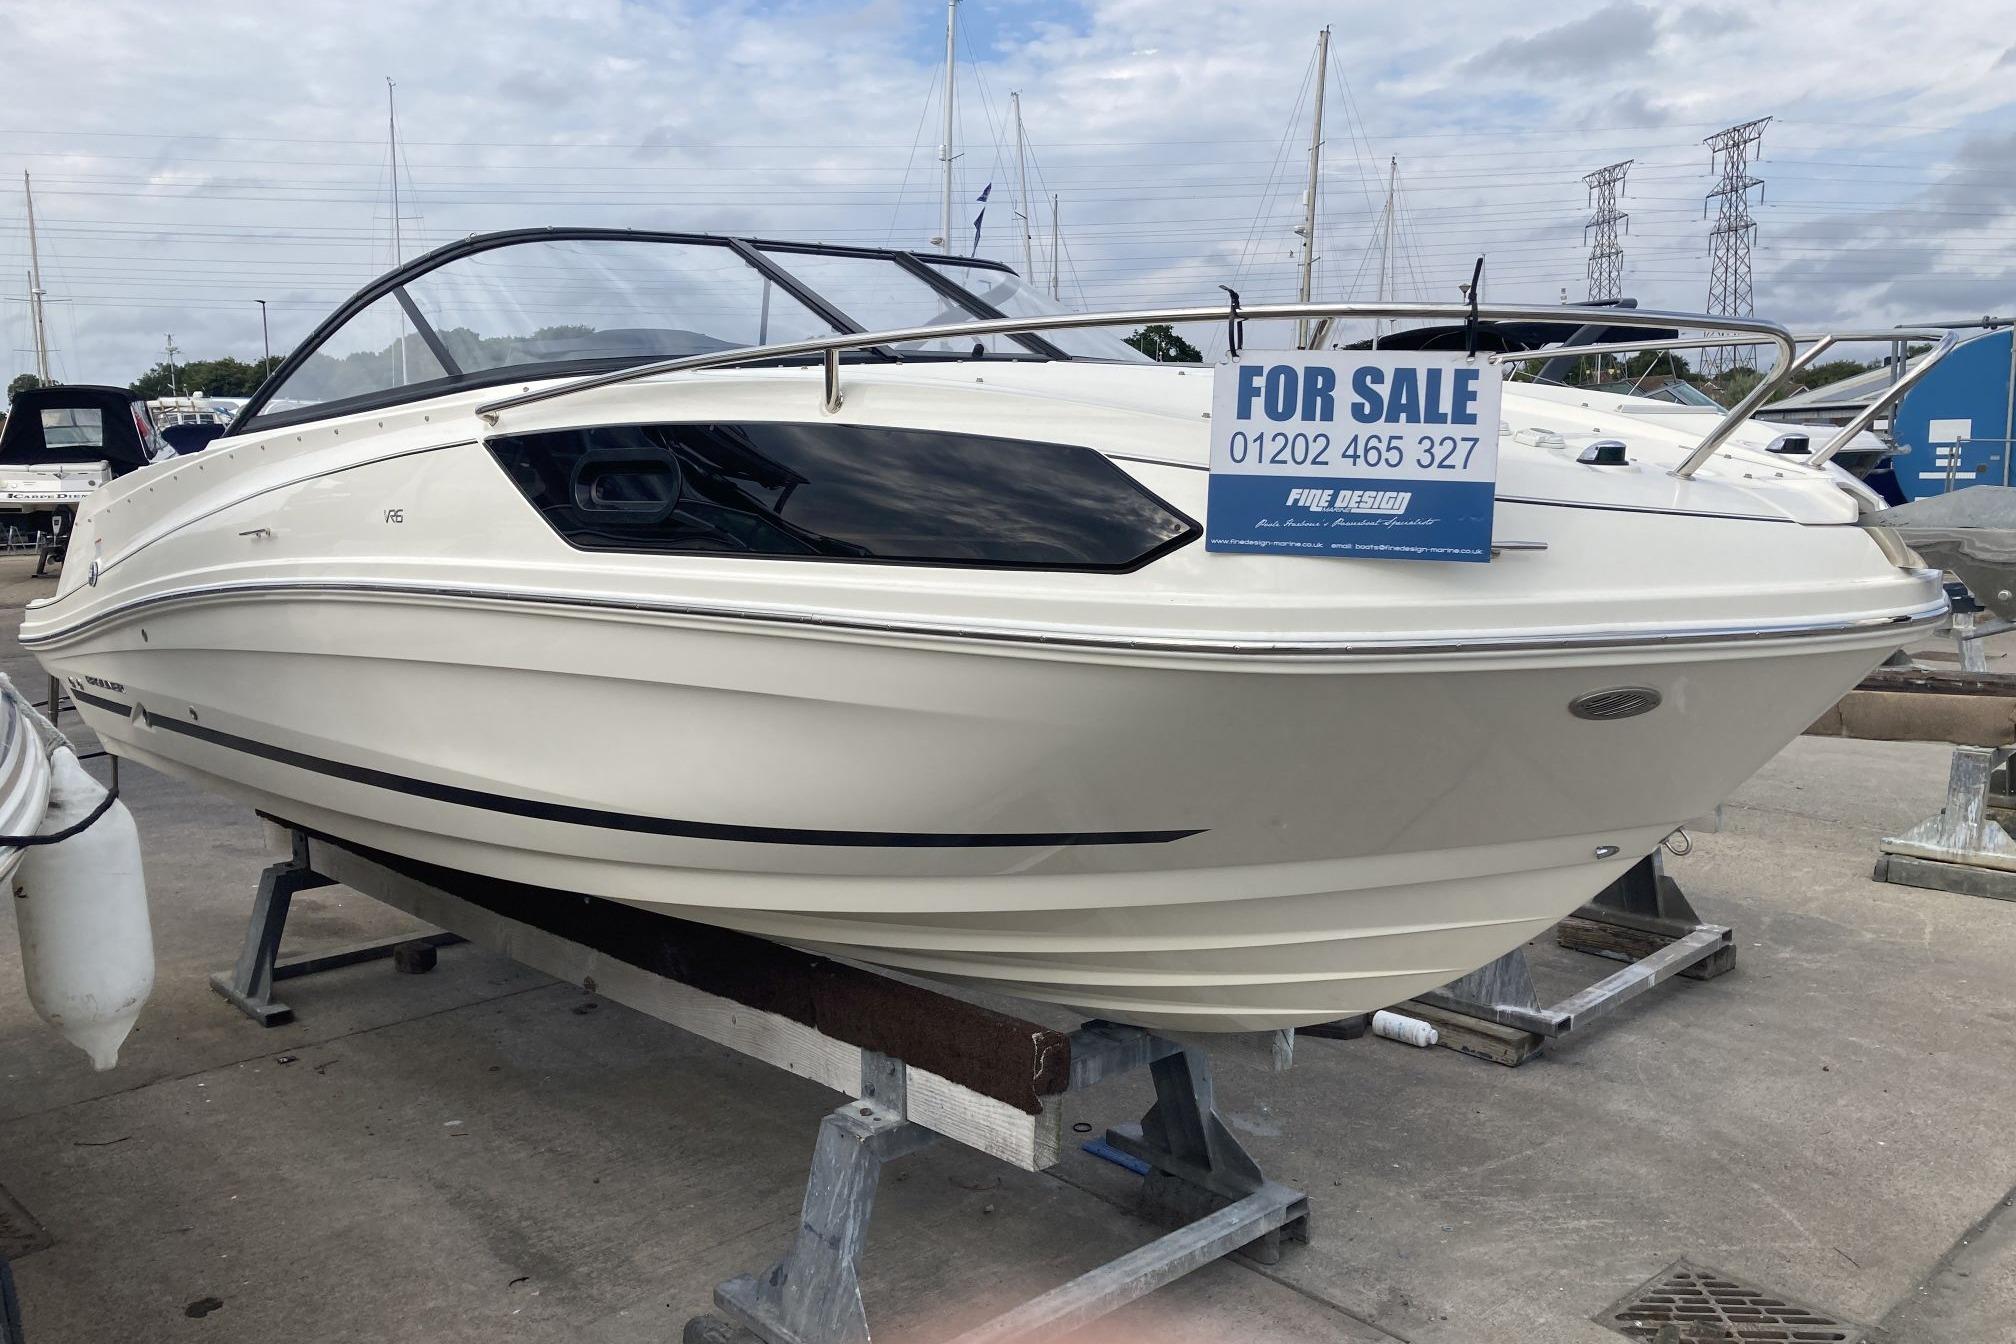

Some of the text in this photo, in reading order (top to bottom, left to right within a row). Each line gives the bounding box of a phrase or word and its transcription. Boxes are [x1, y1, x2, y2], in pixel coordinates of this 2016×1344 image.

[1236, 364, 1481, 425] FOR SALE
[1229, 431, 1481, 470] 01202 465 327
[1285, 488, 1413, 515] FINE DESIGN
[1254, 519, 1281, 528] Poole
[1331, 517, 1382, 528] Powerboat
[1210, 538, 1324, 549] www.finedesign-marine.co.uk
[1355, 543, 1484, 555] boats@finedesign-marine.co.uk
